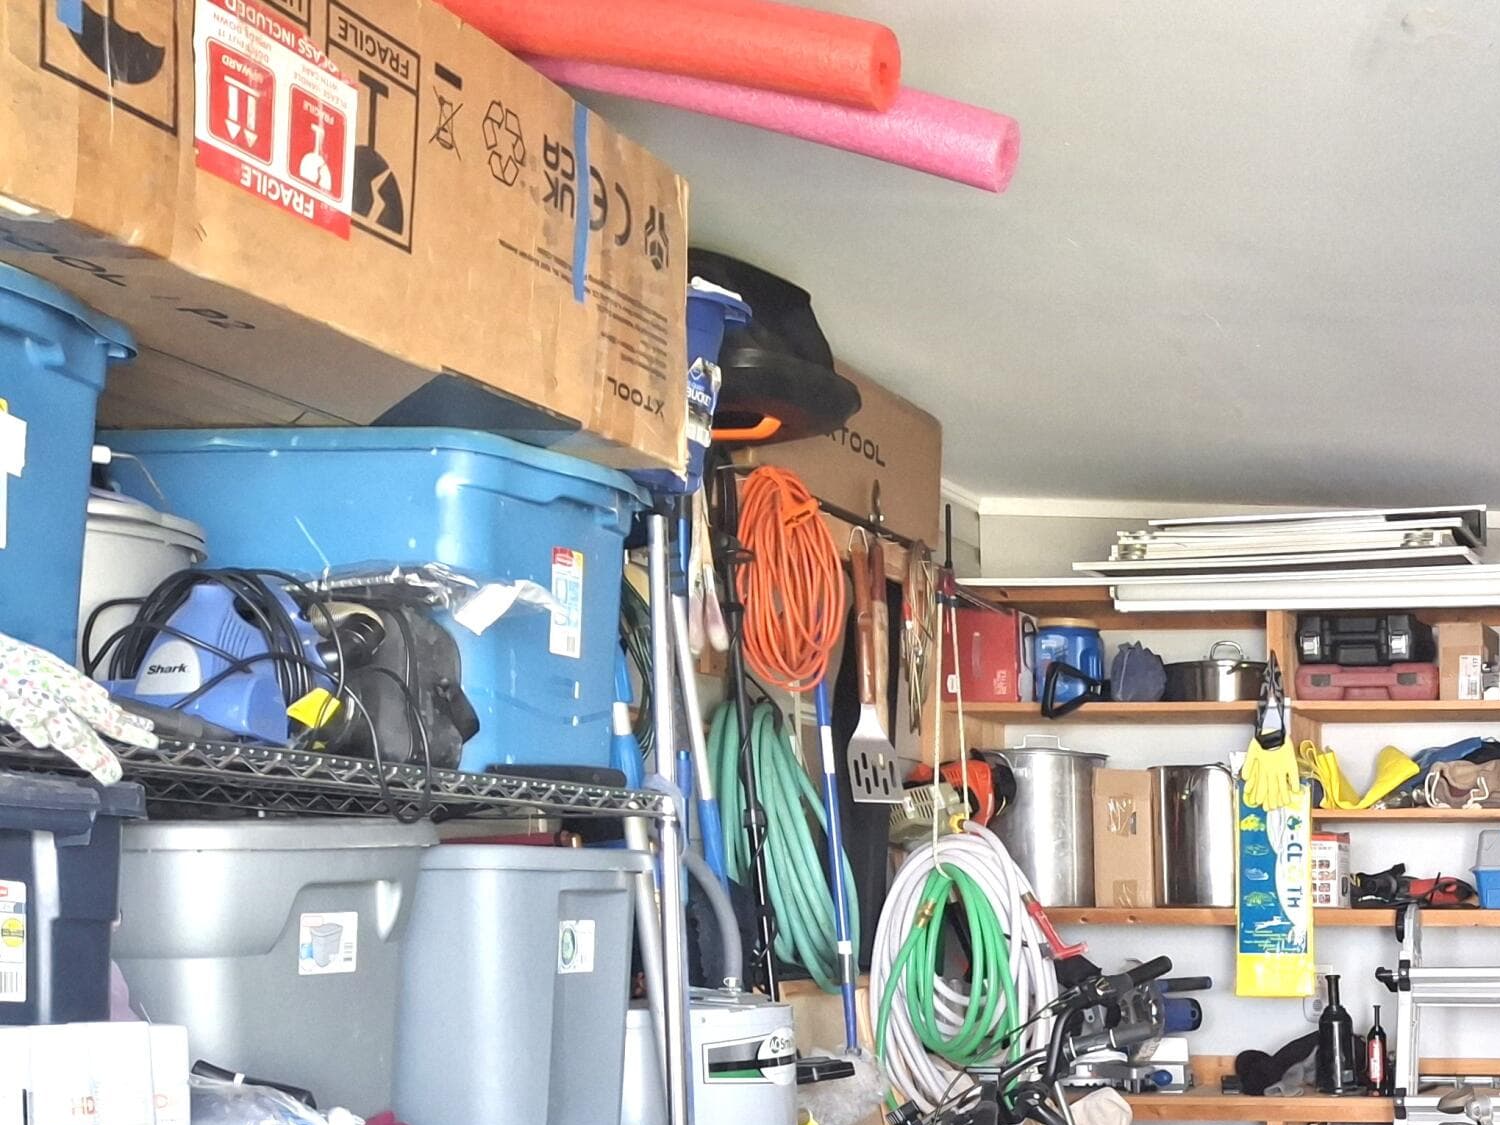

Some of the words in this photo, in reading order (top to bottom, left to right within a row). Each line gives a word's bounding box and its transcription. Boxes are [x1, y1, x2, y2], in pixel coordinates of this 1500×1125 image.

[338, 16, 409, 79] FRAGILE
[240, 164, 315, 220] FRAGILE
[607, 375, 666, 419] XTOOL
[147, 663, 188, 675] Shark
